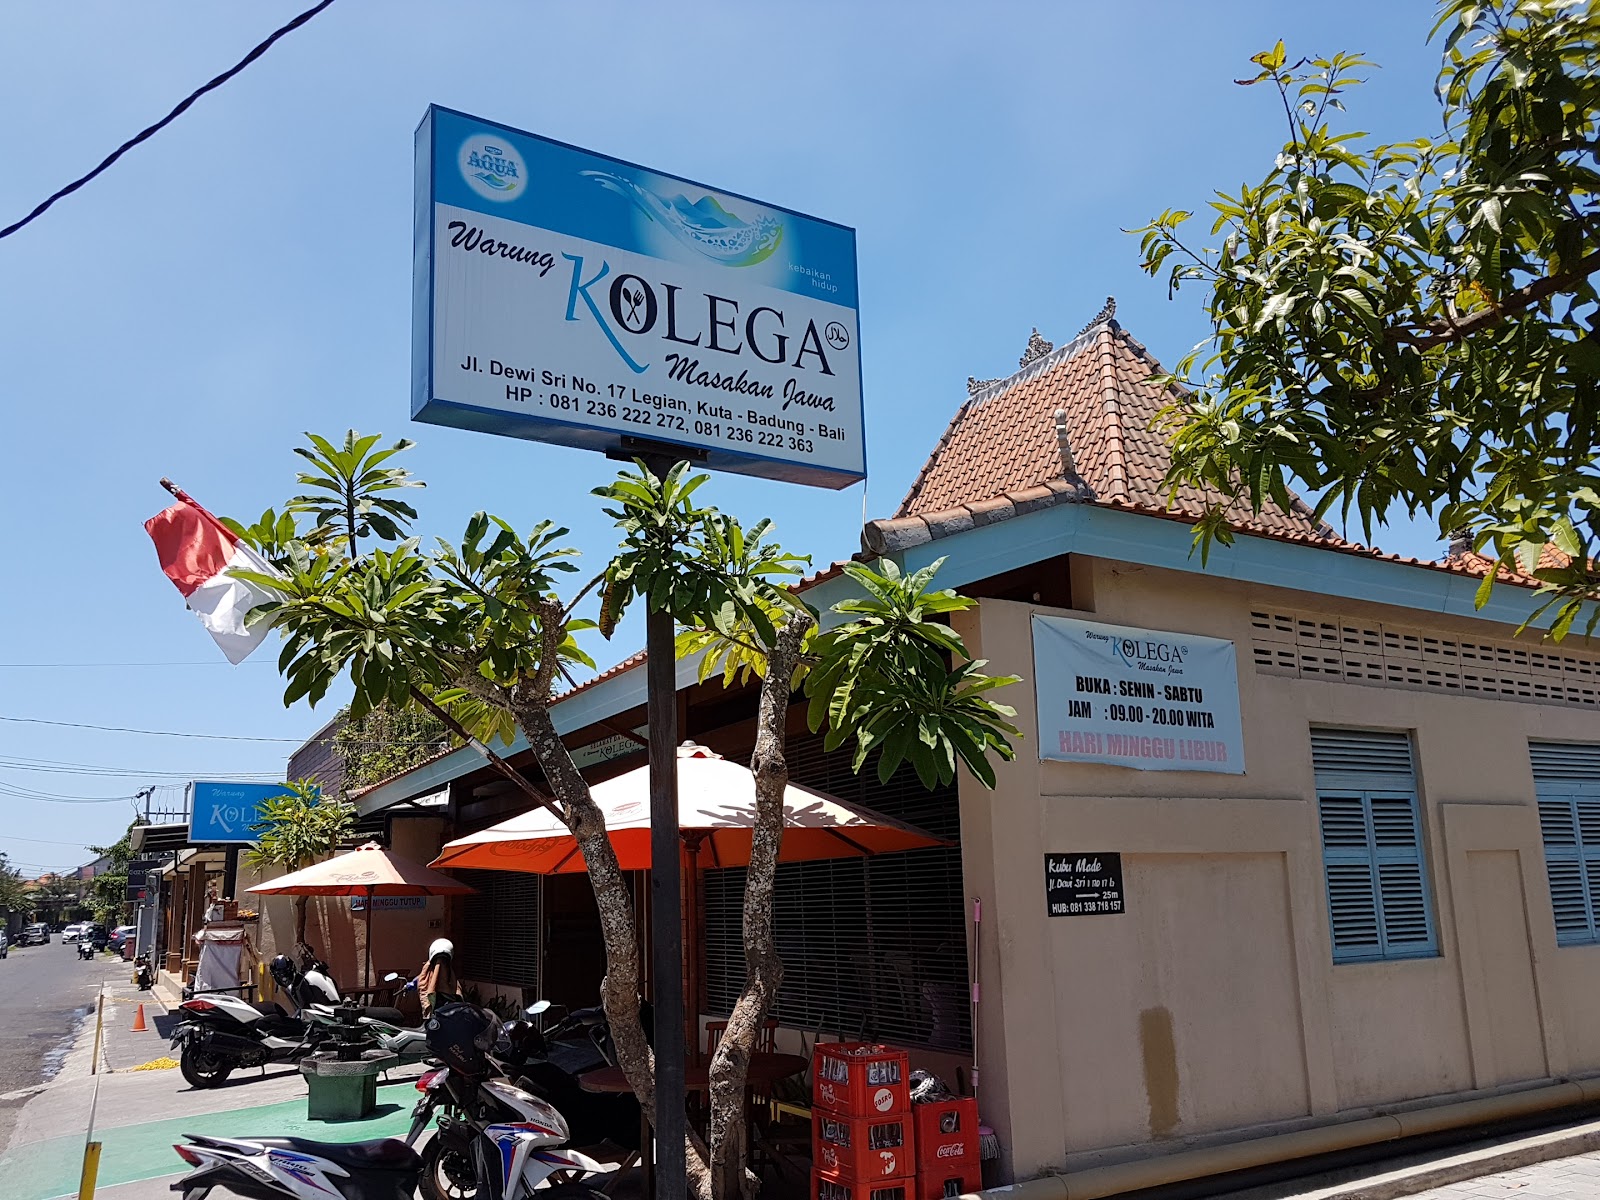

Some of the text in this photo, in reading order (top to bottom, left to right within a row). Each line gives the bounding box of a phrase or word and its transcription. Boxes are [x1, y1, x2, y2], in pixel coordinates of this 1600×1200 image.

[467, 150, 520, 179] AQUA
[448, 220, 556, 277] Warung
[788, 262, 831, 280] kebaikan
[811, 278, 838, 293] hidup
[561, 250, 836, 377] KOLEGA
[665, 353, 836, 412] Masakan Jawa
[460, 355, 483, 373] Jl.
[490, 360, 535, 383] Dewi
[541, 370, 566, 389] Sri
[572, 375, 601, 395] No.
[607, 383, 626, 400] 17
[632, 388, 692, 415] Legian,
[697, 400, 733, 421] Kuta
[747, 409, 805, 436] Badung
[818, 423, 845, 441] Bali
[506, 384, 532, 402] HP
[550, 393, 579, 412] 081
[586, 400, 617, 419] 236
[622, 407, 651, 425] 222
[656, 412, 689, 434] 272,
[694, 420, 721, 438] 081
[726, 426, 753, 443] 236
[758, 431, 784, 448] 222
[788, 436, 813, 454] 363
[1085, 630, 1109, 644] Warung
[1110, 635, 1184, 669] KOLEGA
[1137, 661, 1184, 677] Masakan Jawa
[1075, 675, 1111, 695] BUKA
[1119, 682, 1155, 699] SENIN
[1164, 684, 1203, 704] SABTU
[1068, 699, 1092, 719] JAM
[1110, 703, 1143, 723] 09.00
[1152, 707, 1184, 727] 20.00
[1186, 710, 1215, 729] WITA
[1058, 730, 1228, 762] HARI MINGGU LIBUR
[211, 788, 245, 798] Warung
[210, 803, 263, 833] KOLE
[1048, 857, 1102, 873] Kubu Made
[1074, 875, 1086, 888] Sri
[1109, 877, 1115, 887] b
[356, 897, 421, 908] HAR MINGGU TUTUP
[1102, 891, 1118, 899] 25m
[1052, 900, 1121, 913] HUB: 081 338 718 157
[874, 1093, 892, 1108] SOSRO
[530, 1117, 553, 1129] HONDA
